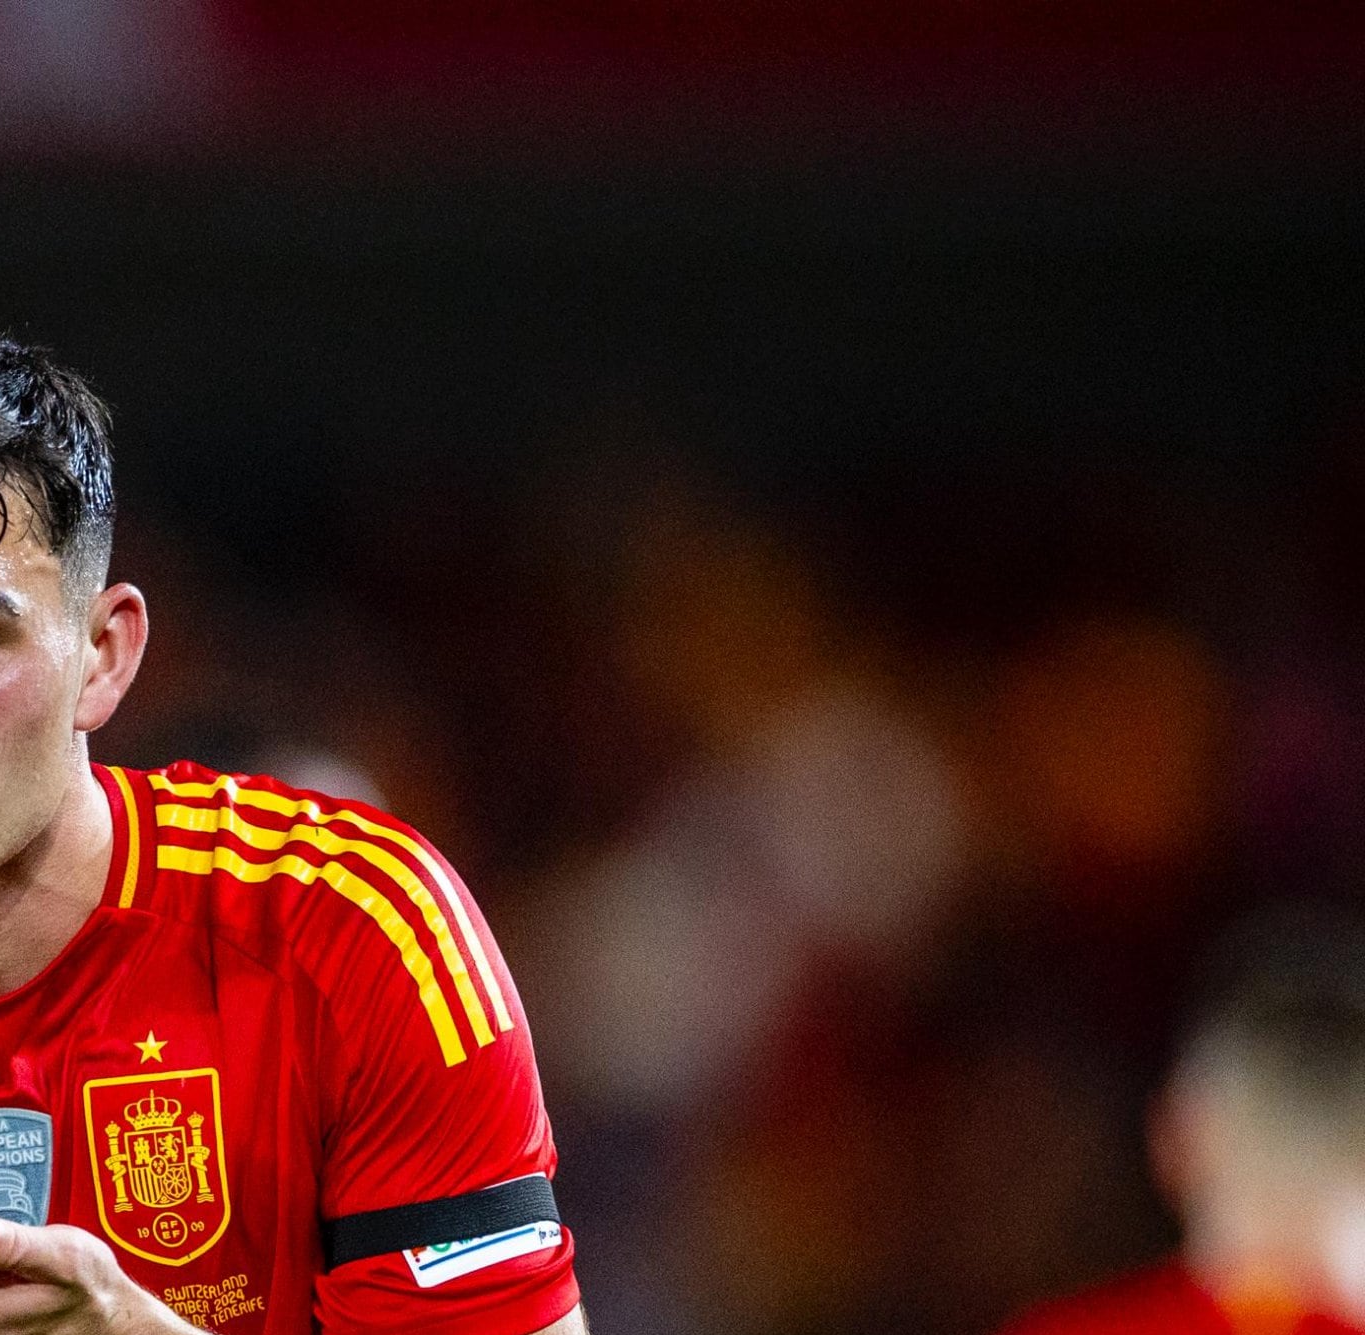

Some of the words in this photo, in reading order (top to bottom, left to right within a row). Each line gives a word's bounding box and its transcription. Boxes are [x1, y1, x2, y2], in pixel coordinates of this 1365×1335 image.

[137, 1227, 150, 1238] 19
[190, 1221, 205, 1232] 09
[164, 1274, 249, 1302] SWITZERLAND
[213, 1288, 245, 1312] 2024
[211, 1296, 266, 1327] TENERIFE
